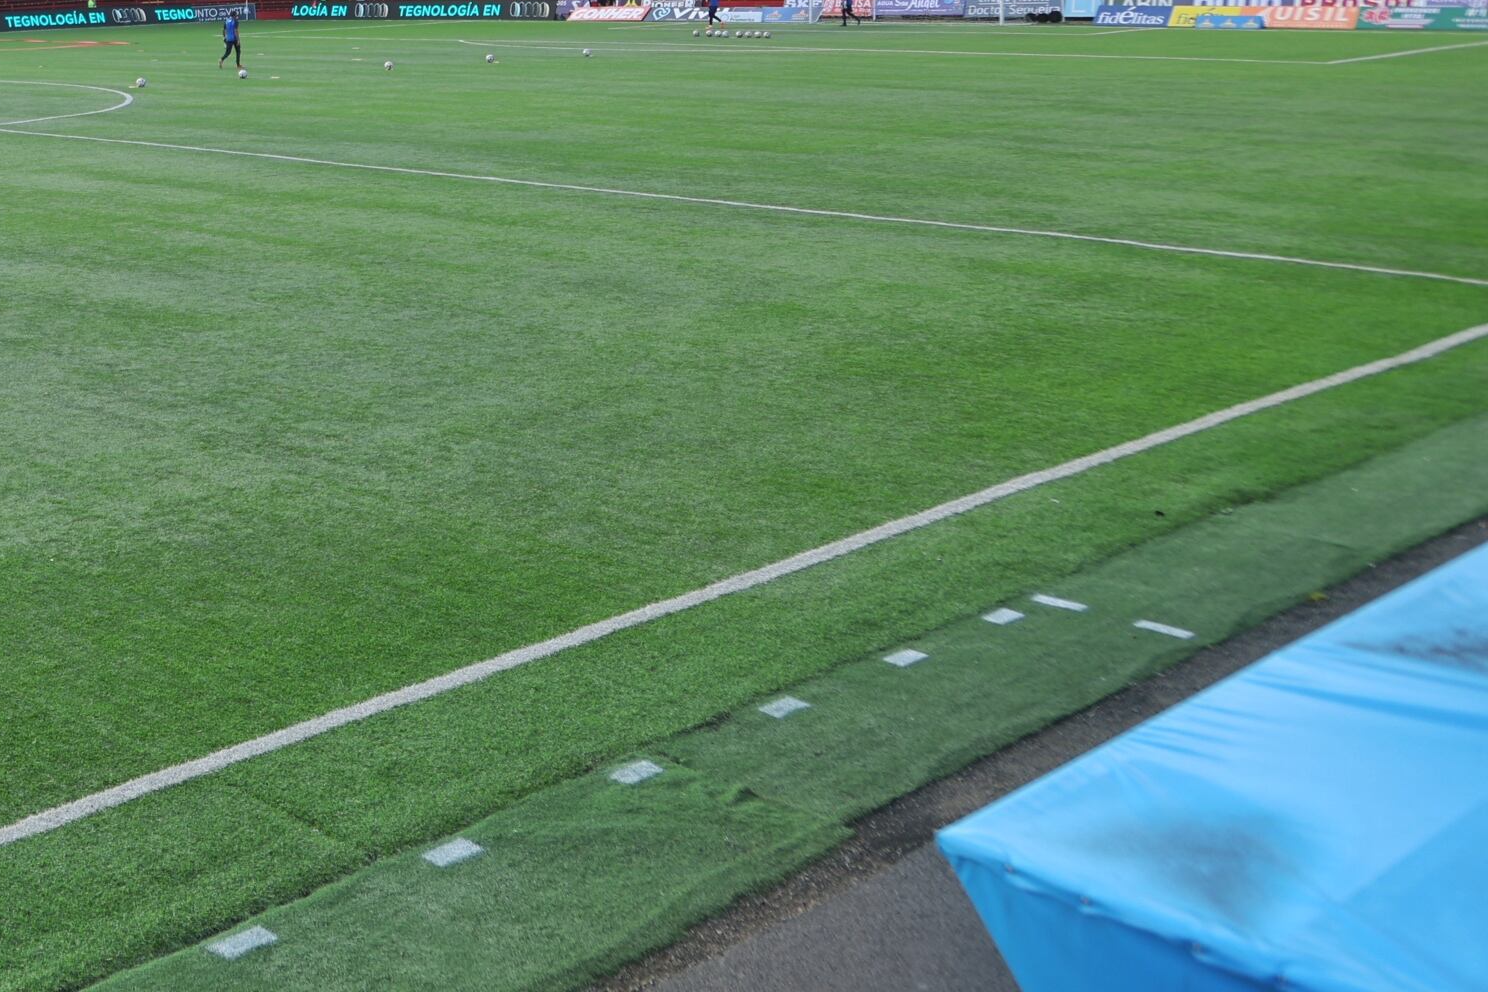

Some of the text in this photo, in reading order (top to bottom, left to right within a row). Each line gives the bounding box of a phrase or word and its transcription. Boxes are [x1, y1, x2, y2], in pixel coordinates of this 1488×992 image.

[292, 3, 348, 17] LOGÍA EN
[483, 4, 501, 17] EN
[1096, 6, 1164, 25] fidélitas
[89, 12, 106, 24] EN
